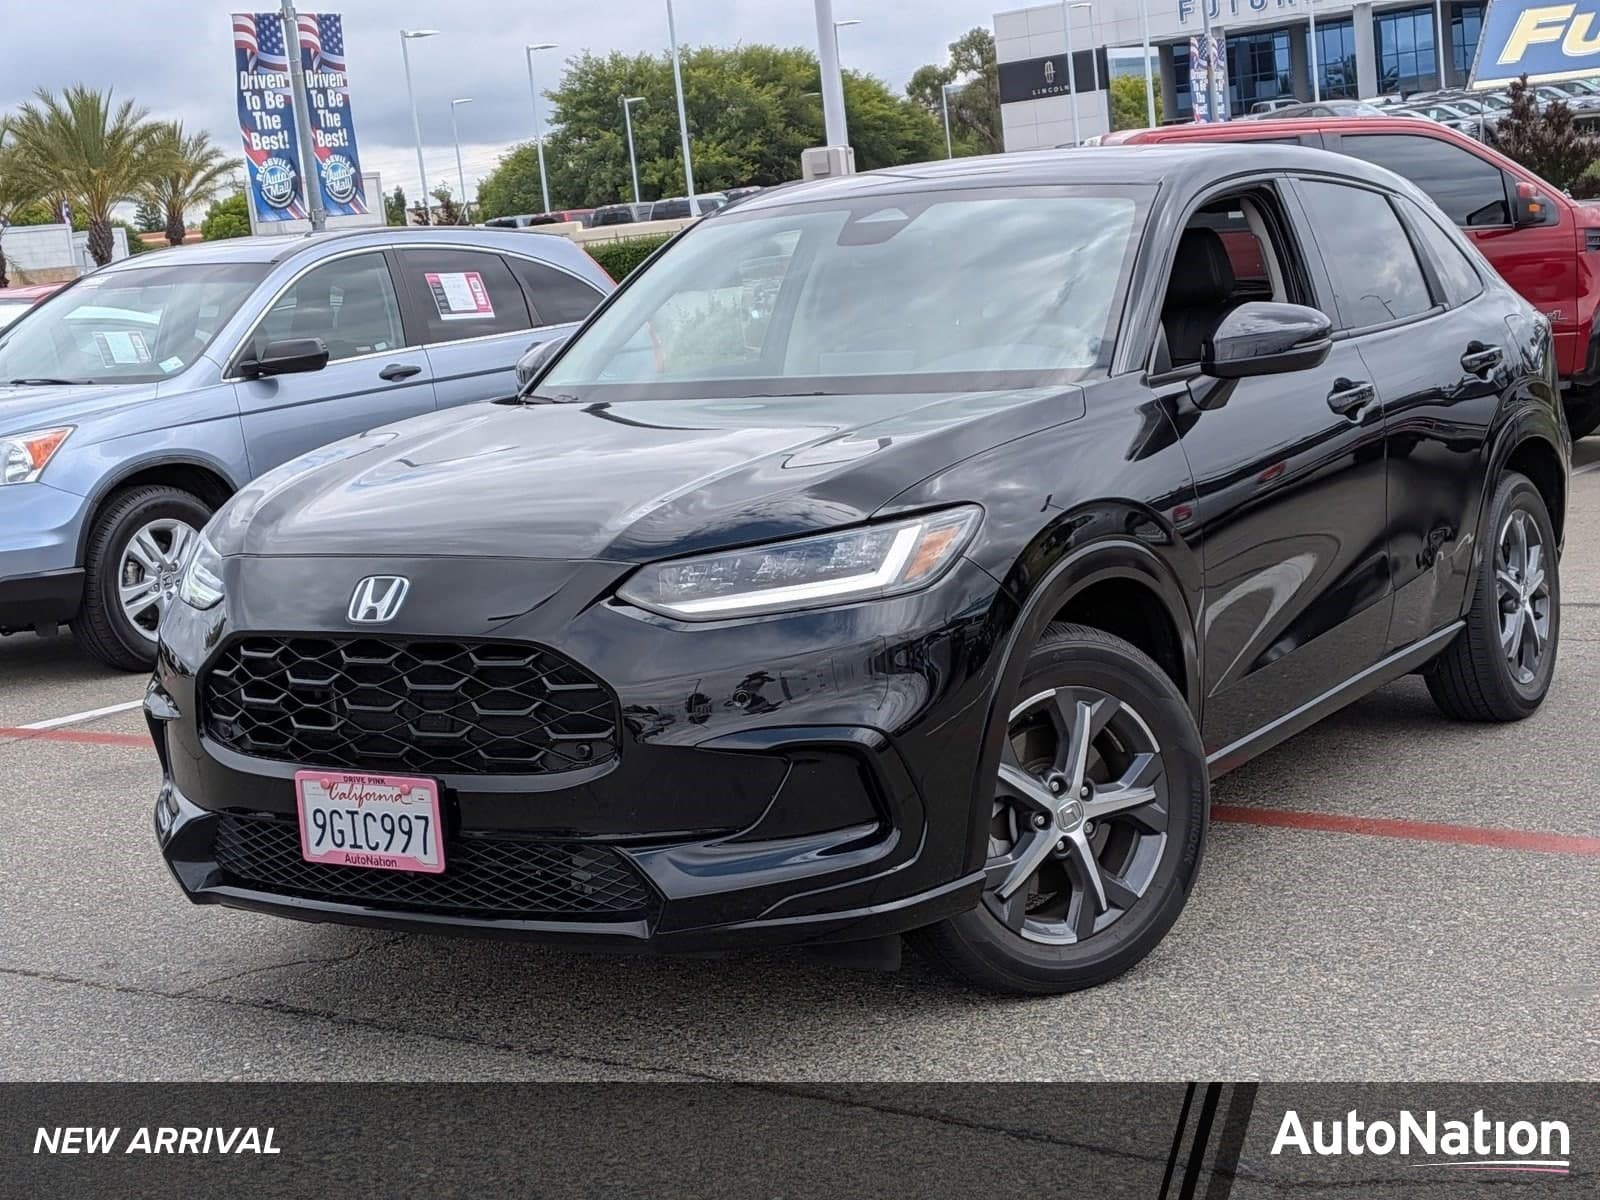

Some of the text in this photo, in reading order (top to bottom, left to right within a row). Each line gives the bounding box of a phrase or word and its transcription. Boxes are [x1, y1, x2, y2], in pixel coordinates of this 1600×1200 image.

[240, 70, 285, 90] Driven
[305, 69, 344, 88] Driven
[243, 90, 285, 110] To Be
[310, 89, 344, 108] To Be
[1032, 85, 1070, 96] LINCOLN
[252, 111, 281, 130] The
[318, 109, 341, 127] The
[250, 130, 290, 151] Best!
[316, 128, 349, 147] Best!
[343, 775, 386, 785] DRIVE PINK
[328, 782, 412, 808] California
[312, 807, 430, 856] 9GIC997
[344, 853, 398, 868] AutoNation
